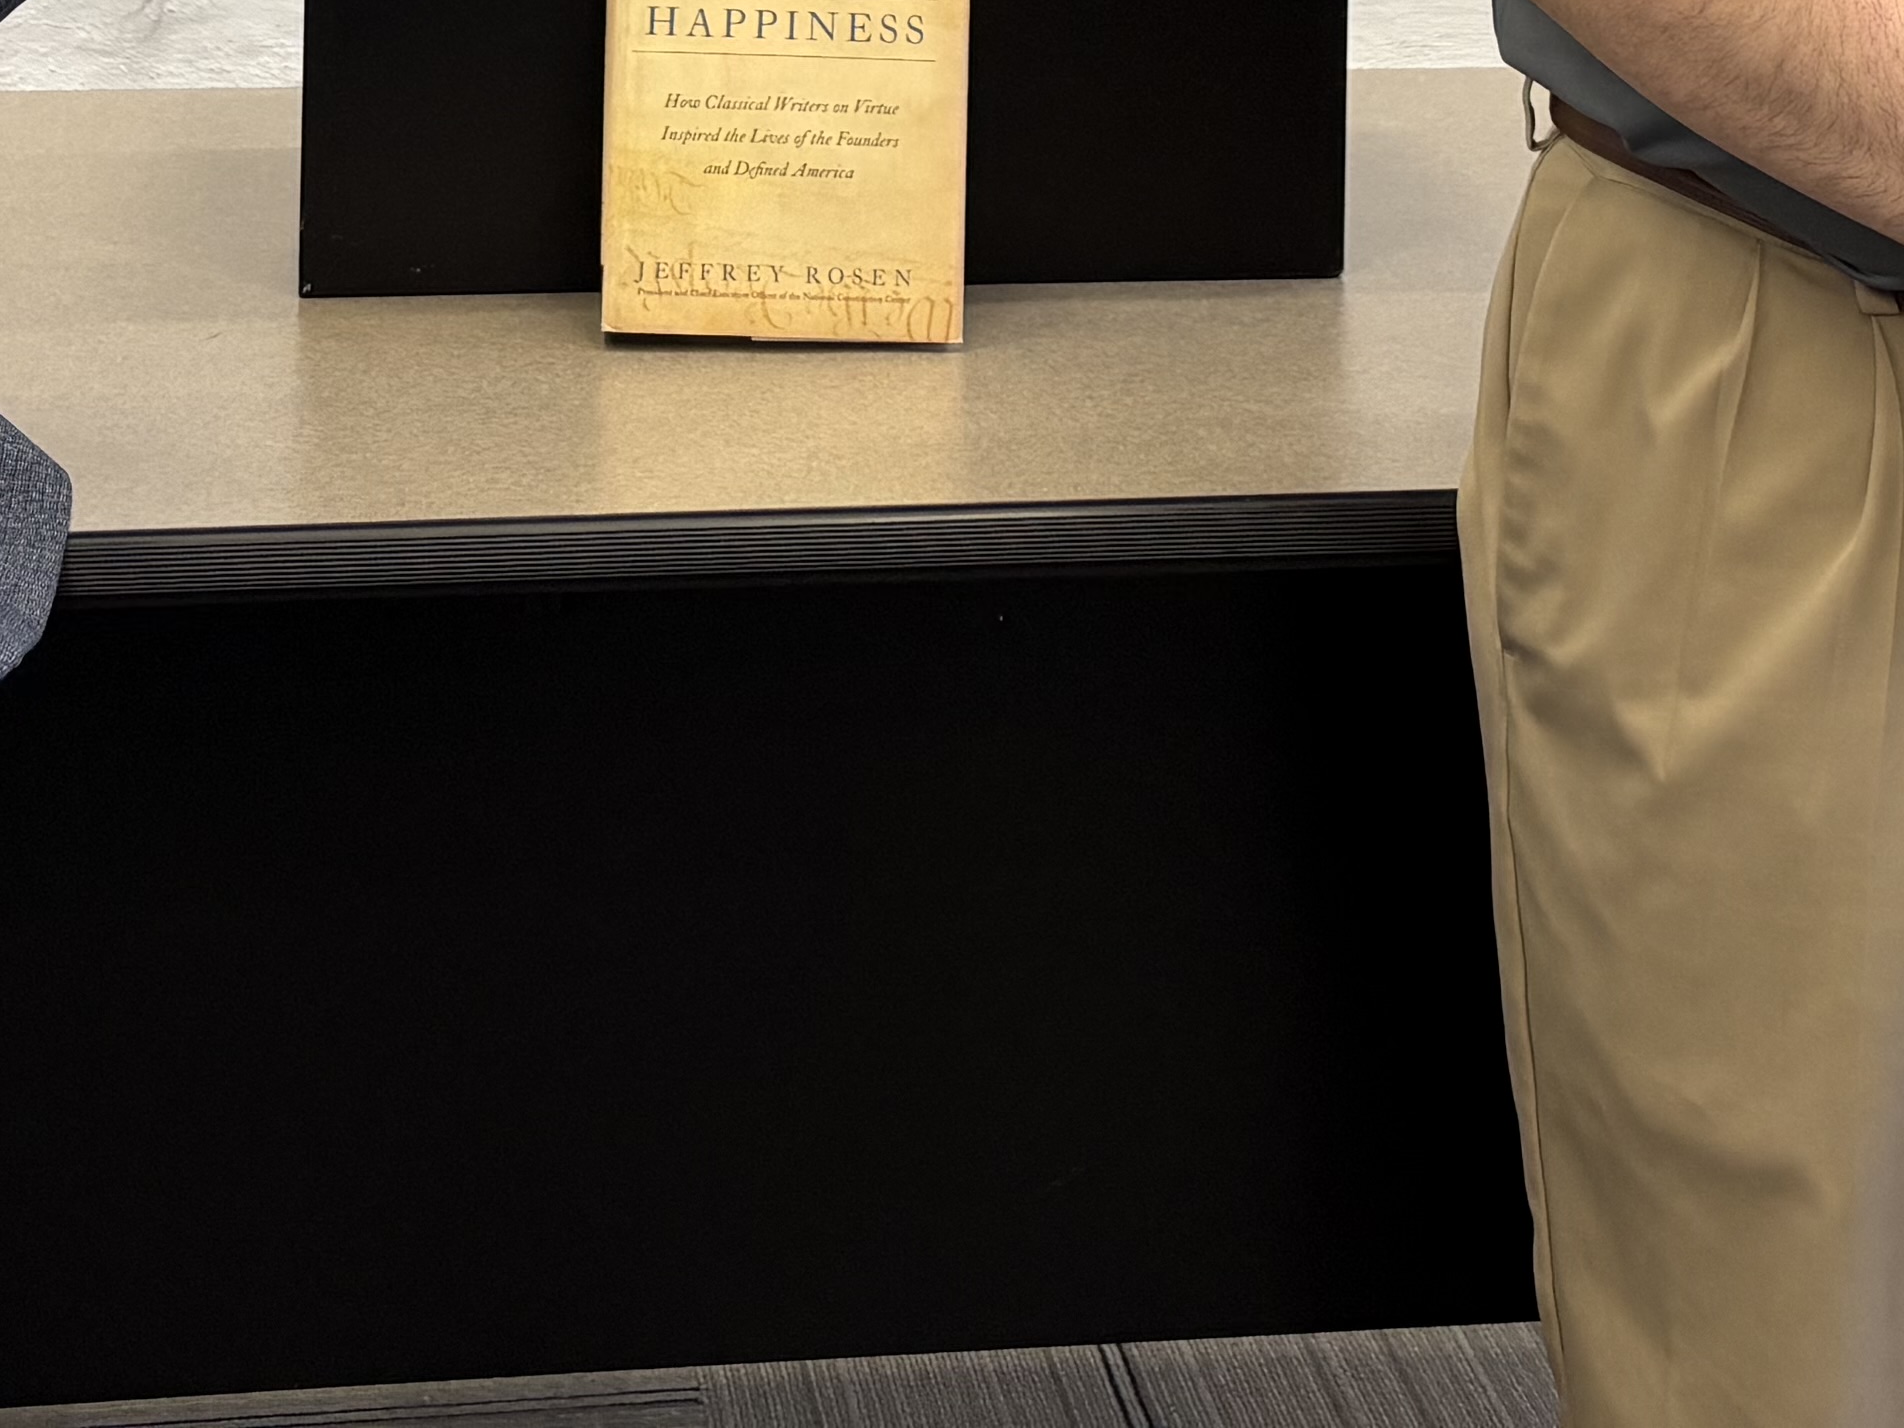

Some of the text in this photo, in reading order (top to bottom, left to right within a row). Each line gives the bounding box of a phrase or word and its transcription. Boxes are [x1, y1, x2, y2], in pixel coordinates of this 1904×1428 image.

[645, 5, 925, 44] HAPPINESS
[664, 93, 900, 116] How Classical Writers on Virtue
[661, 125, 899, 148] Inspired the Lives of the Founders
[703, 160, 855, 179] and Defined America
[634, 261, 912, 287] JEFFREY ROSEN
